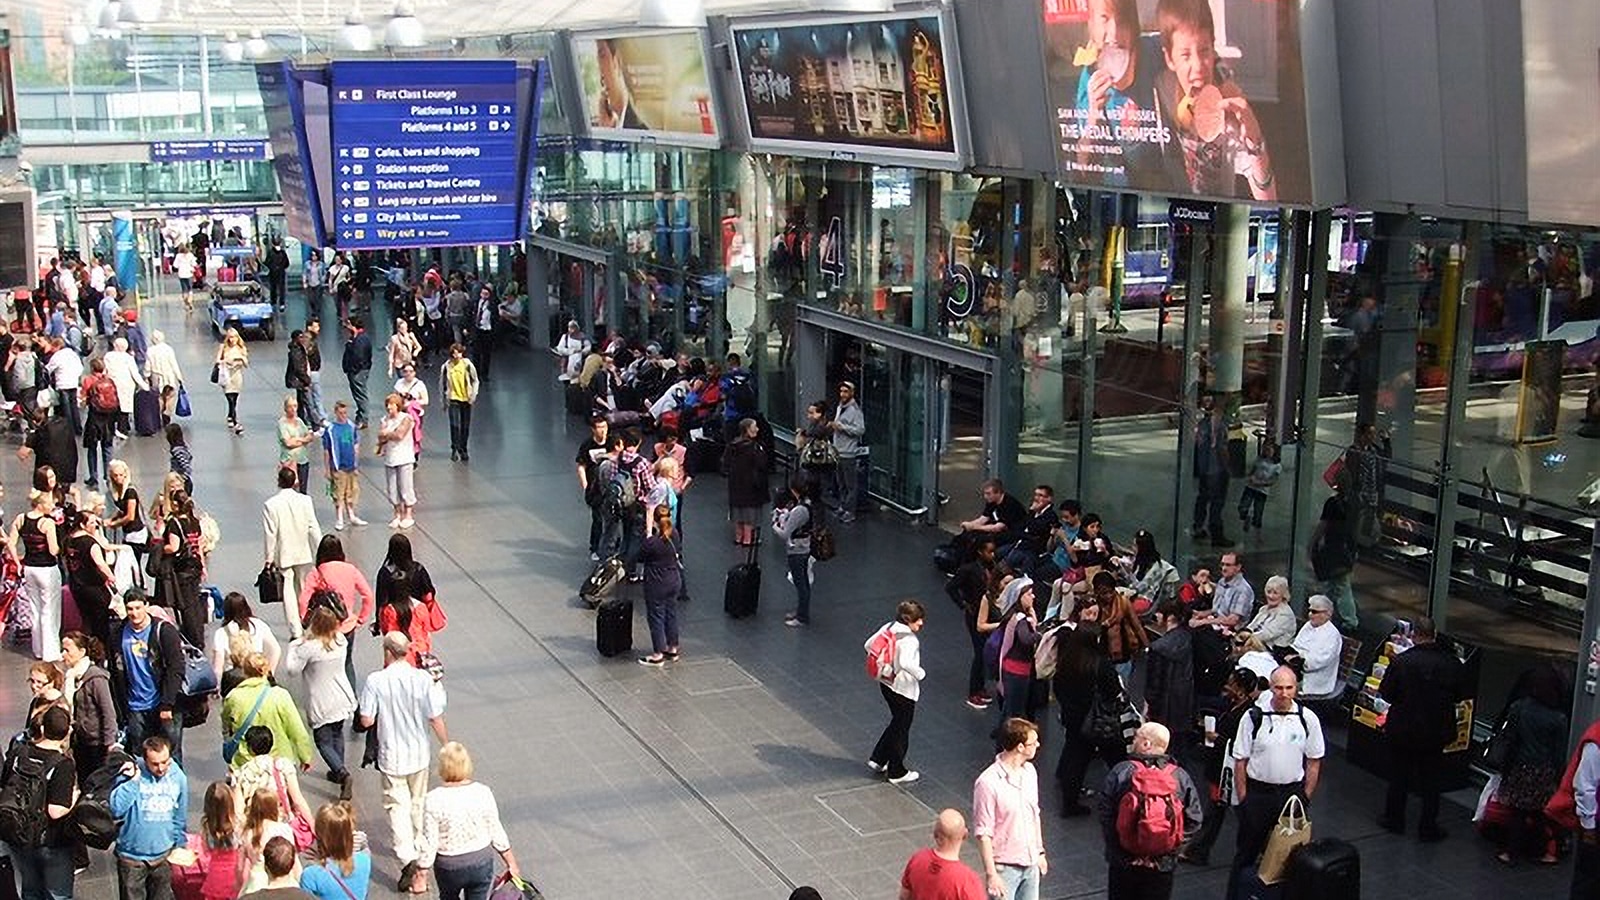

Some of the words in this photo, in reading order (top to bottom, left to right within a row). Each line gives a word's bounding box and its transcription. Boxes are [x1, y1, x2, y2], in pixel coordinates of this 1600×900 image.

[376, 90, 397, 100] First
[398, 89, 421, 100] Class
[422, 89, 457, 101] Lounge
[410, 105, 452, 116] Platforms
[454, 106, 459, 114] 1
[459, 106, 469, 115] to
[470, 106, 477, 115] 3
[401, 121, 443, 133] Platforms
[444, 121, 452, 131] 4
[453, 121, 468, 131] and
[469, 121, 477, 131] 5
[1059, 123, 1080, 139] THE
[1080, 124, 1114, 141] MEDAL
[1114, 126, 1171, 143] CHOMPERS
[403, 147, 422, 157] bars
[423, 147, 440, 157] and
[441, 146, 480, 157] shopping
[376, 164, 407, 175] Station
[408, 164, 449, 175] reception
[376, 180, 406, 190] Tickets
[408, 179, 424, 189] and
[426, 179, 449, 189] Travel
[451, 178, 480, 188] Centre
[378, 196, 399, 208] Long
[400, 195, 418, 206] stay
[419, 195, 432, 204] car
[432, 194, 452, 206] park
[452, 194, 467, 204] and
[467, 194, 481, 203] car
[481, 193, 497, 203] hire
[376, 213, 394, 224] City
[395, 212, 411, 221] link
[412, 212, 429, 221] bus
[376, 229, 397, 240] Way
[398, 229, 415, 238] out
[819, 216, 844, 289] 4
[947, 233, 975, 317] 5
